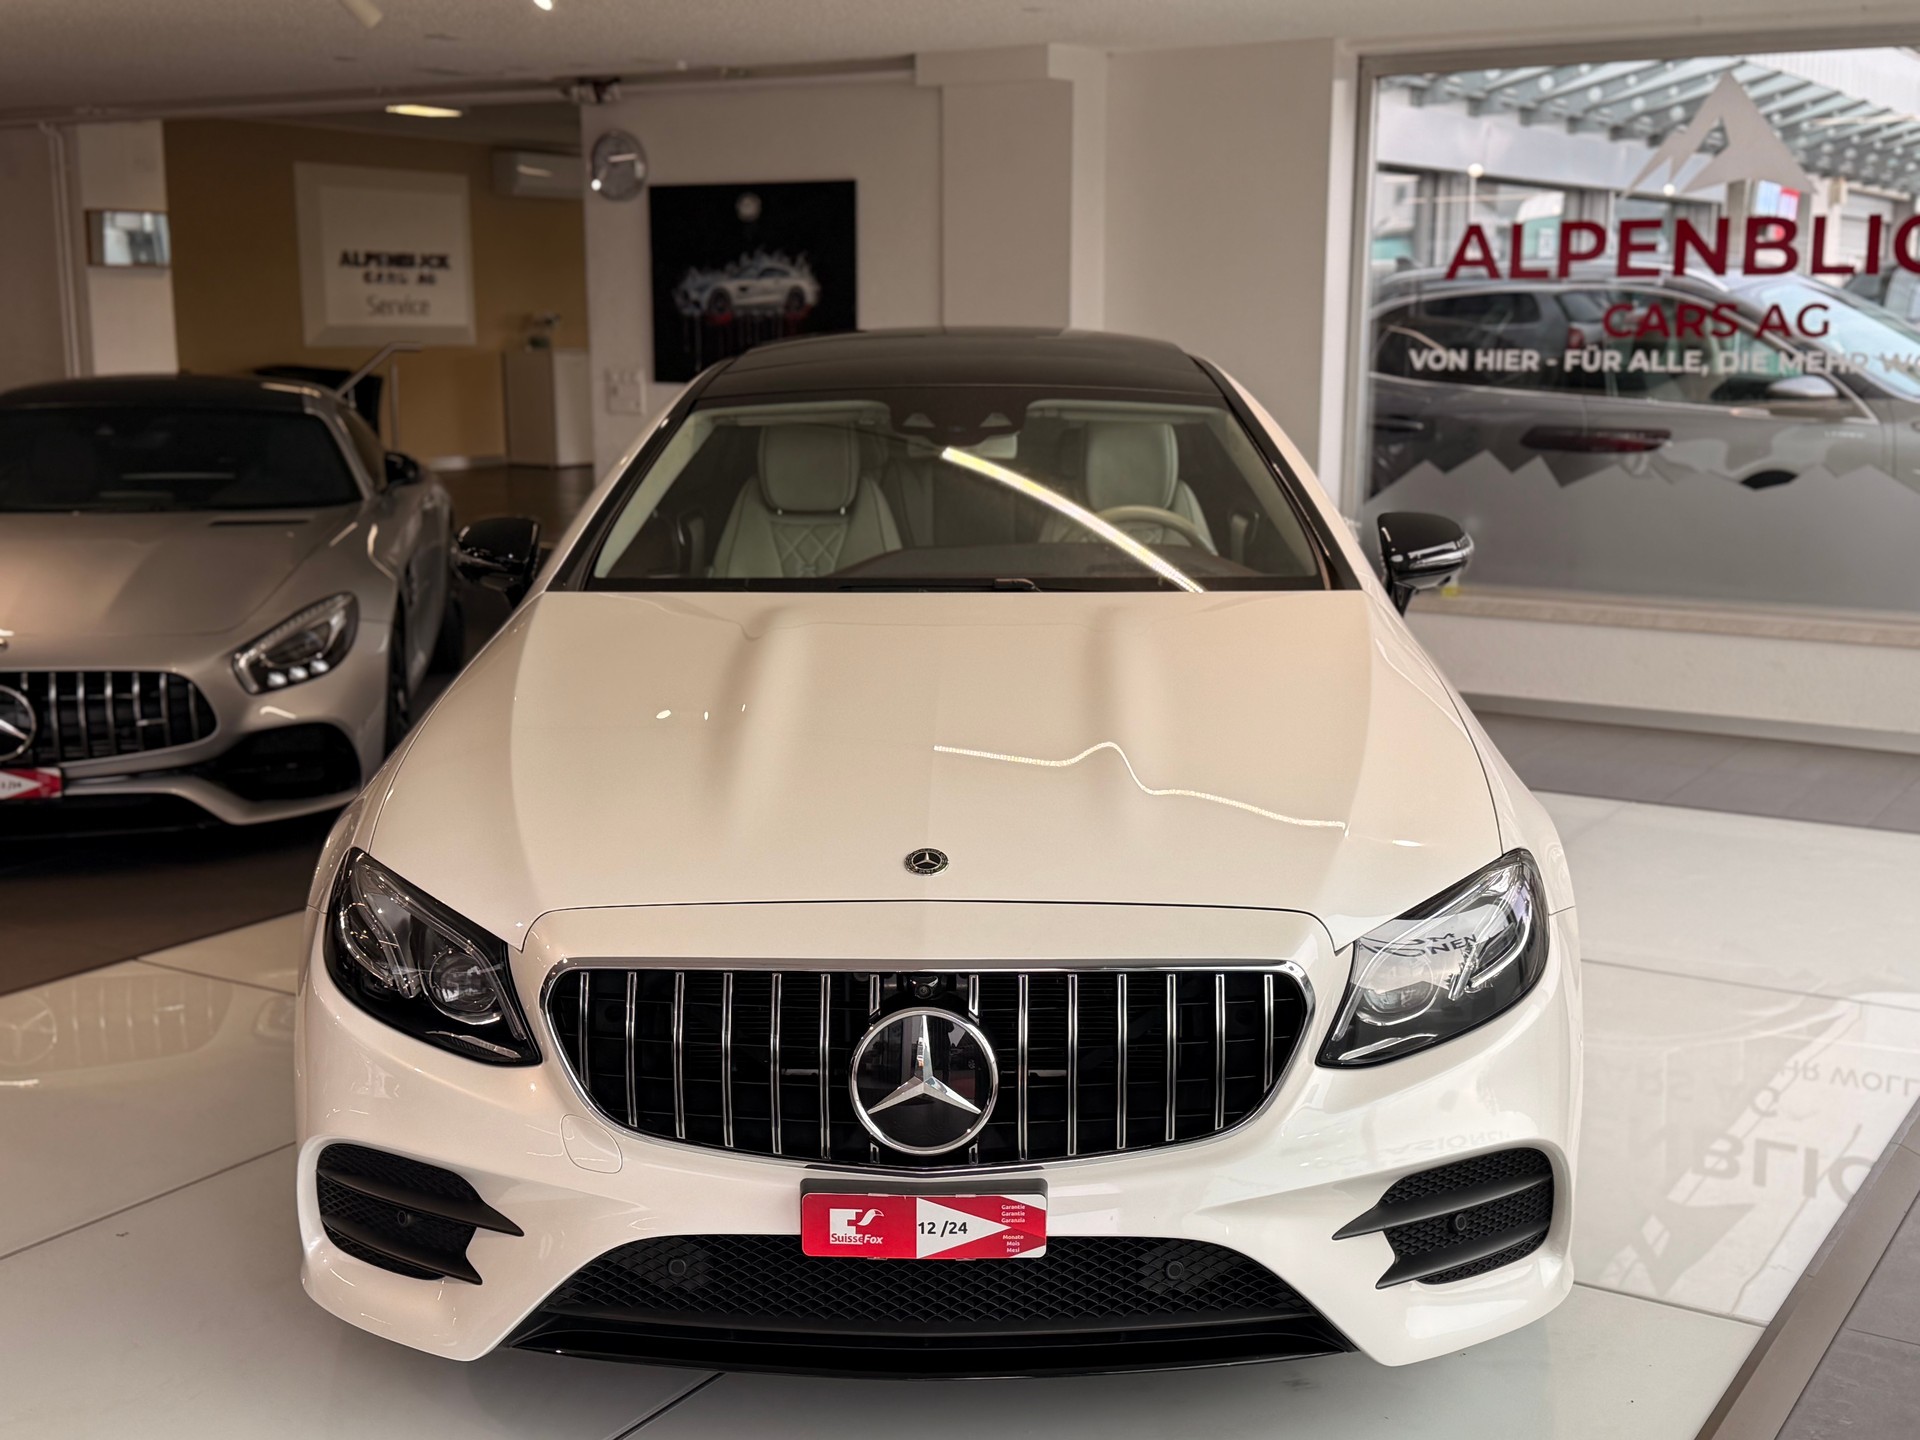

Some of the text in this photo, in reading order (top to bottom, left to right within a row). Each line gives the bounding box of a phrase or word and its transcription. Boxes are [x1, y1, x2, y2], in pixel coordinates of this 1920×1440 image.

[366, 294, 431, 316] Service
[1602, 303, 1829, 339] CARS AG
[1409, 349, 1468, 371] VON
[1474, 349, 1540, 372] HIER
[1564, 345, 1621, 373] FÜR
[1627, 349, 1710, 377] ALLE,
[1719, 350, 1774, 374] DIE
[1779, 351, 1869, 376] MEHR
[918, 1222, 936, 1234] 12
